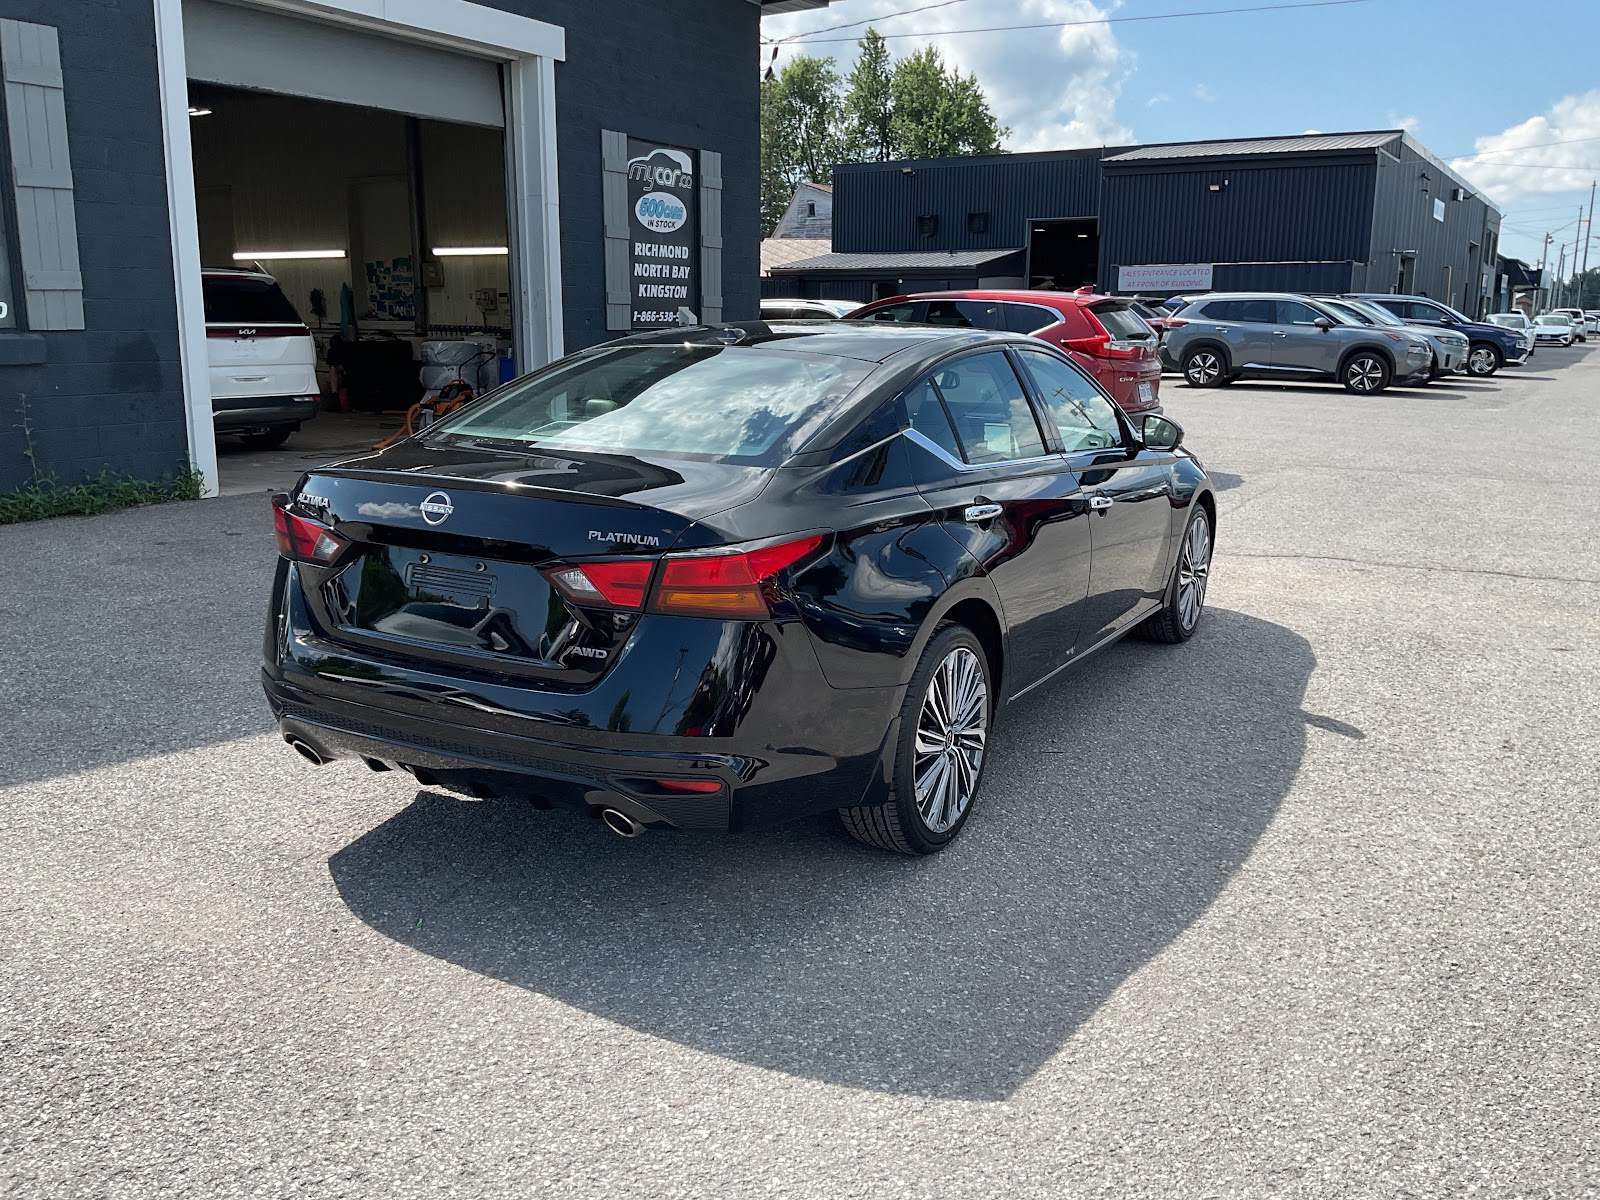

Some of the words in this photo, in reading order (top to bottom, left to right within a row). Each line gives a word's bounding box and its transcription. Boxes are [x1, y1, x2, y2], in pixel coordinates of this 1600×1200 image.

[655, 221, 676, 229] STOCK
[635, 242, 689, 259] RICHMOND
[634, 263, 670, 278] NORTH
[672, 265, 690, 279] BAY
[1122, 270, 1141, 278] SALES
[1142, 269, 1178, 277] ENTRANCE
[1180, 268, 1210, 276] LOCATED
[1136, 280, 1160, 288] FRONT
[1160, 280, 1170, 288] OF
[1171, 279, 1203, 287] BUILDING
[638, 284, 688, 298] KINGSTON
[420, 503, 454, 515] NISSAN
[588, 530, 659, 546] PLATINUM
[570, 646, 608, 659] AWD
